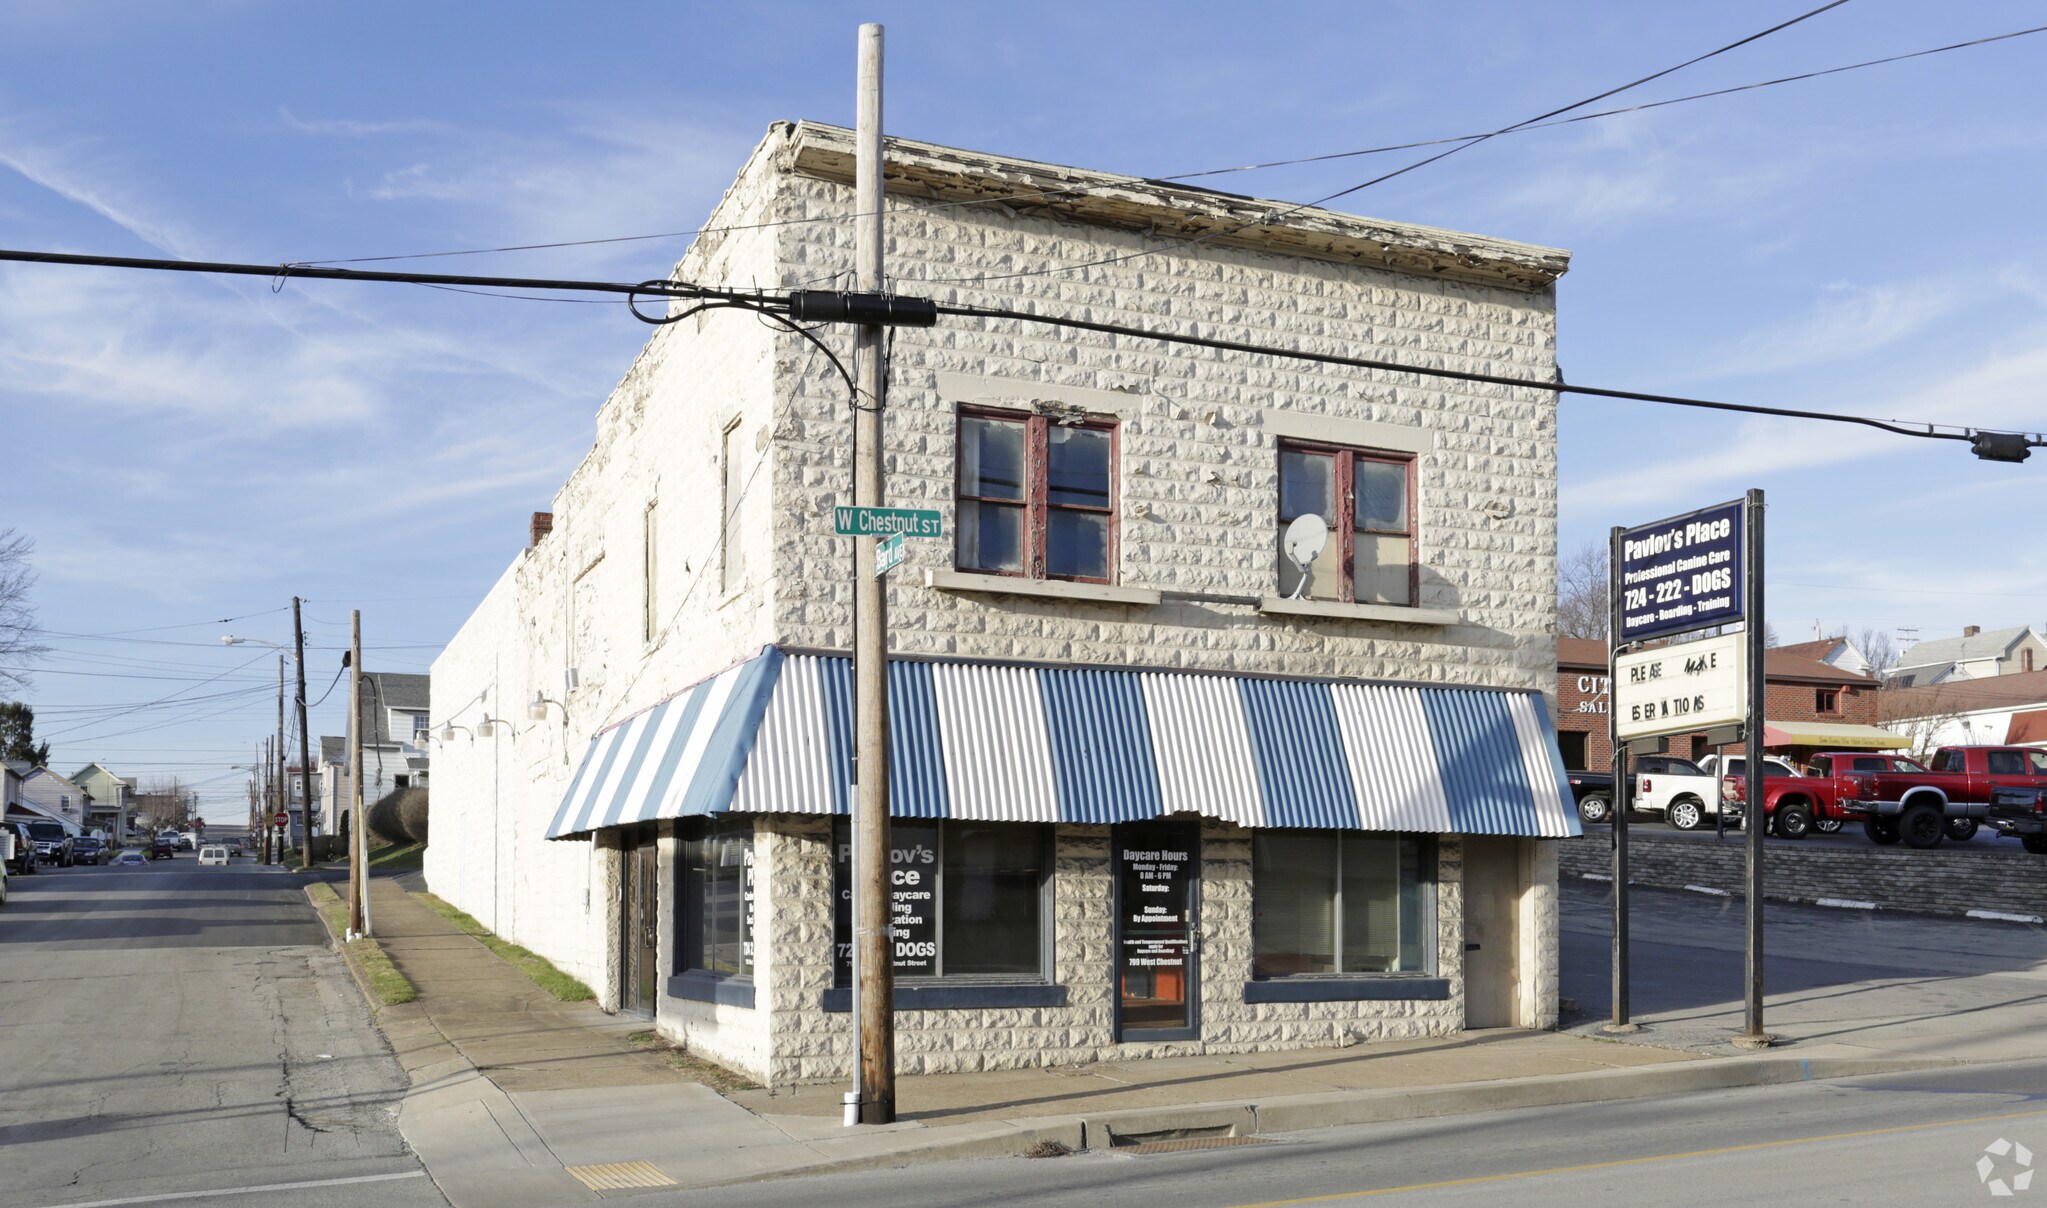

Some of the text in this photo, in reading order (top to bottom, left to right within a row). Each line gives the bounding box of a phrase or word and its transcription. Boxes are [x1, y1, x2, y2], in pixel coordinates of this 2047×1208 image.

[837, 509, 940, 534] W Chestnut ST
[1624, 518, 1730, 562] Pavlov's Place
[1624, 550, 1731, 585] Professional Canine Care
[1624, 587, 1647, 611] 724
[1656, 579, 1682, 603] 222
[1692, 567, 1731, 595] DOGS
[1626, 613, 1655, 628] Daycare
[1659, 604, 1693, 620] Boarding
[1697, 596, 1730, 612] Training
[1577, 675, 1612, 694] CIT
[1579, 701, 1612, 713] SAL
[1123, 849, 1188, 861] Daycare Hours
[1132, 863, 1156, 871] Monday
[1144, 871, 1154, 880] AM
[1162, 871, 1172, 880] PM
[892, 891, 931, 902] aycare
[1133, 914, 1178, 923] By Appointment
[896, 942, 936, 957] DOGS
[1129, 958, 1182, 966] 799 West Chestnut
